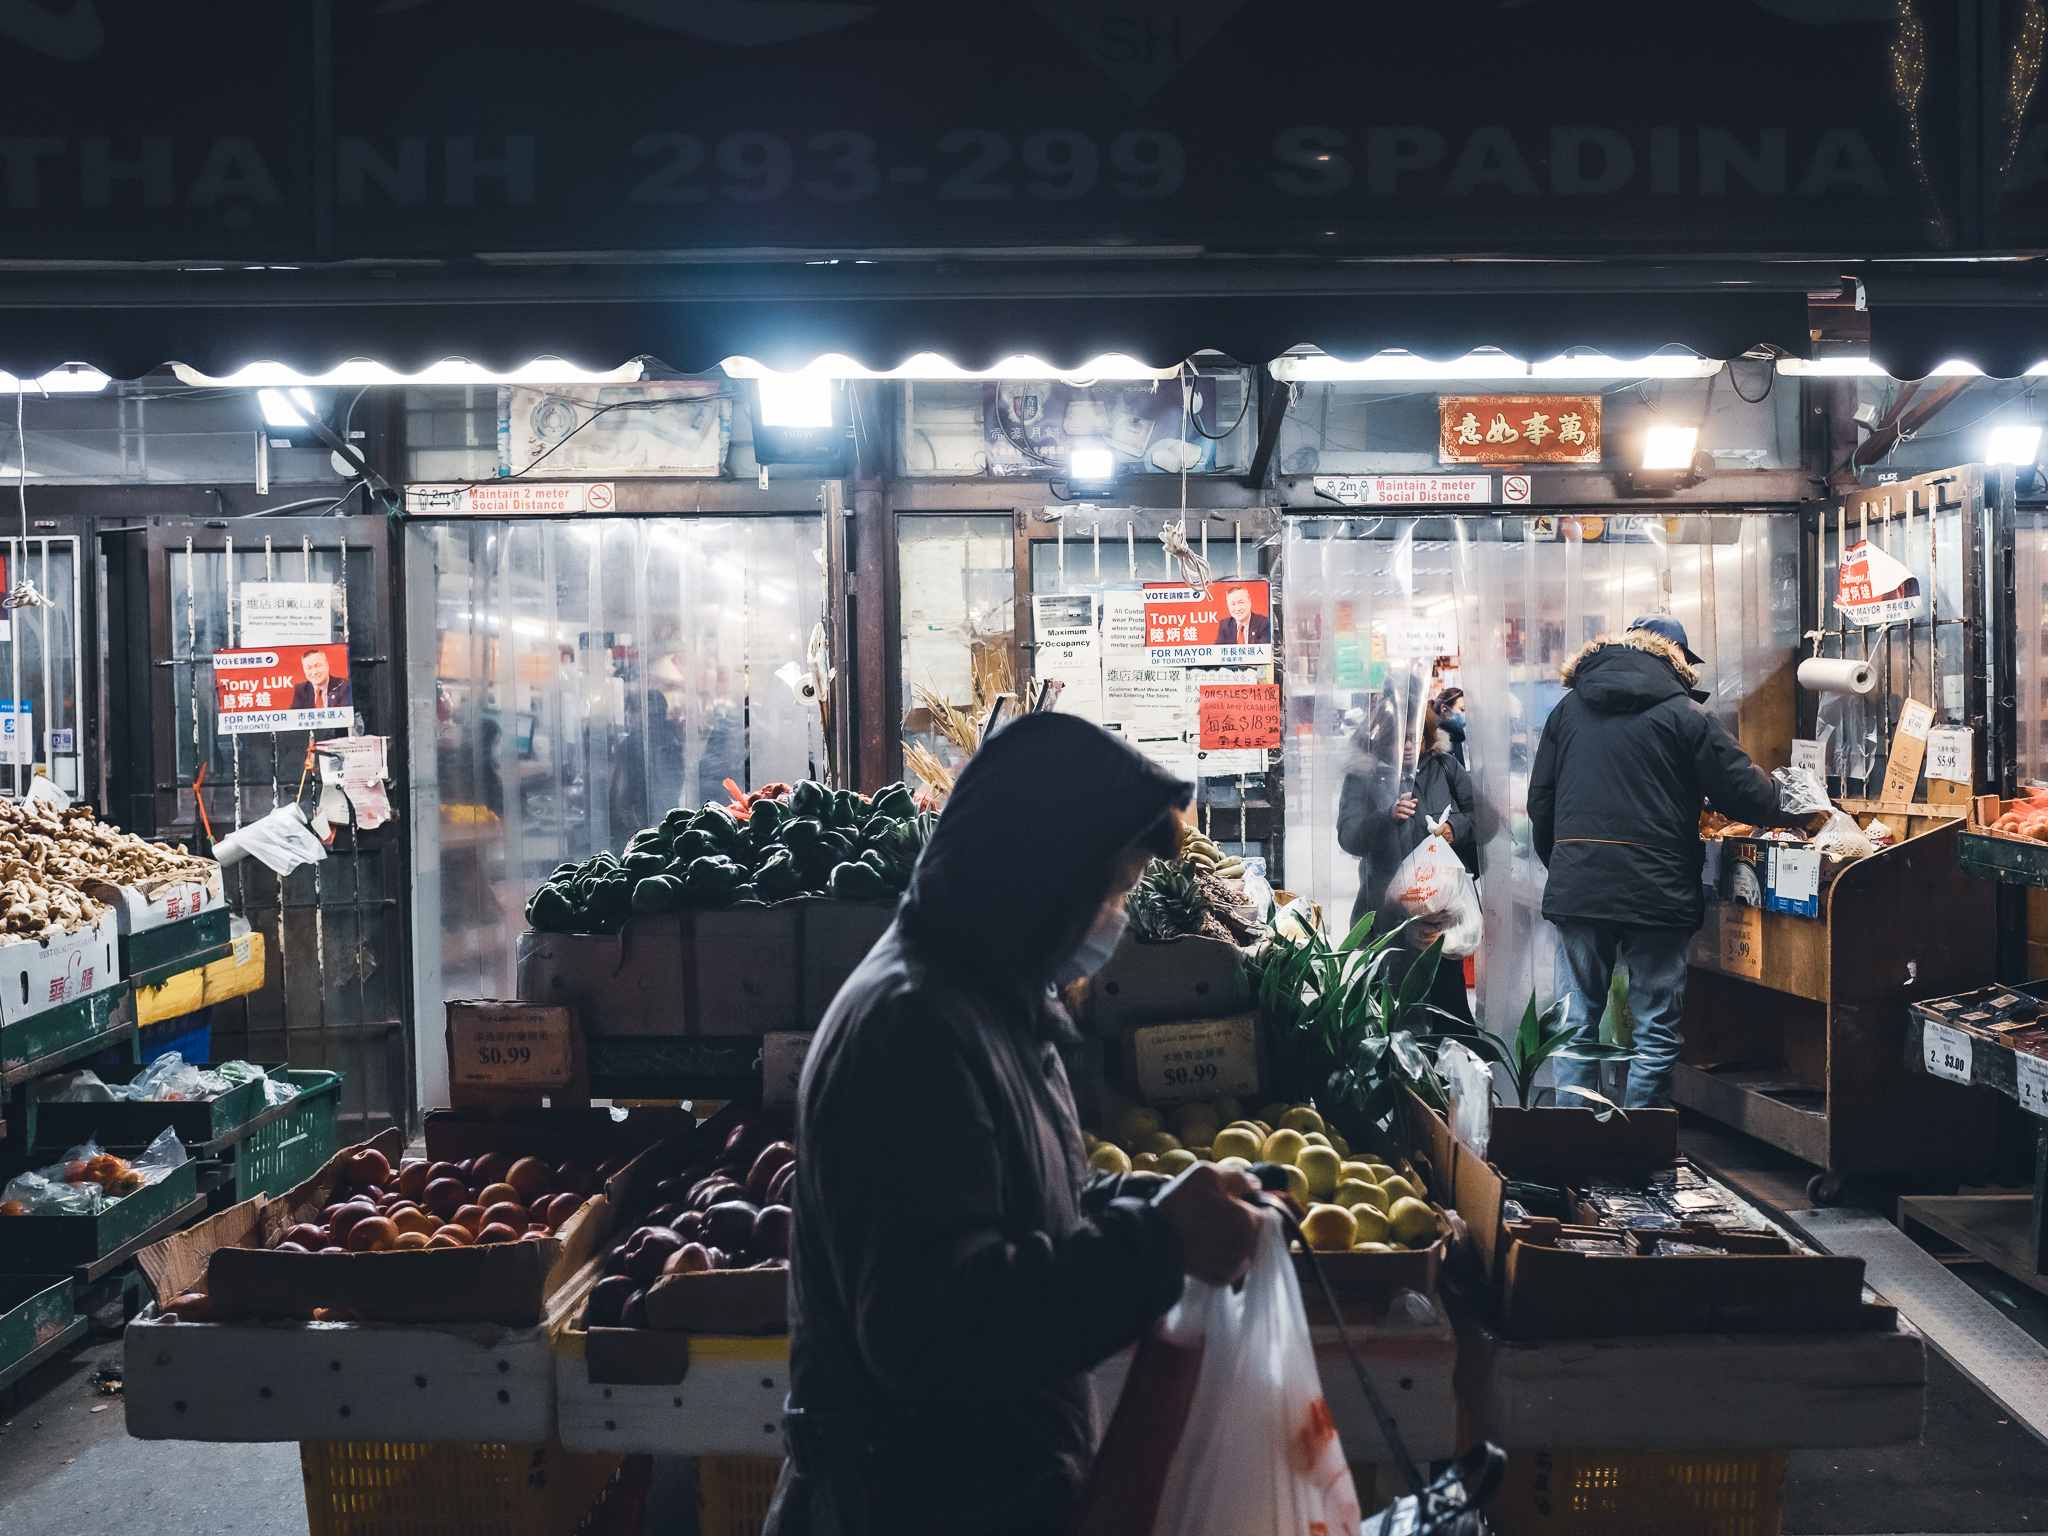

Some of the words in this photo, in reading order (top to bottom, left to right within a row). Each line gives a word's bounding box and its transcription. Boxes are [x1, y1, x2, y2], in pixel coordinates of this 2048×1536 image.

[630, 128, 1188, 201] 293-299
[1270, 125, 1892, 198] SPADINA
[1339, 481, 1357, 491] 2m
[1376, 480, 1427, 490] Maintain
[1431, 480, 1437, 490] 2
[1442, 480, 1475, 490] meter
[469, 489, 519, 499] Maintain
[524, 489, 531, 498] 2
[535, 489, 570, 498] meter
[1379, 491, 1416, 502] Social
[1419, 491, 1471, 501] Distance
[472, 500, 508, 510] Social
[513, 500, 565, 510] Distance
[1561, 521, 1603, 531] MastrCard
[1614, 516, 1650, 530] VISA
[246, 597, 325, 610] 進店須戴口罩
[1886, 600, 1916, 612] 市長候選人
[1856, 605, 1881, 616] MAYOR
[1150, 613, 1186, 627] Tony
[1190, 611, 1218, 624] LUK
[1150, 627, 1198, 643] 陸炳雄
[1045, 640, 1090, 648] Occupancy
[1151, 649, 1171, 658] FOR
[1174, 648, 1213, 657] MAYOR
[1220, 647, 1264, 656] 市長候選人
[1107, 670, 1180, 682] 進店須戴口罩
[220, 679, 259, 693] Tony
[263, 675, 294, 690] LUK
[223, 691, 272, 710] 陸炳雄
[224, 714, 243, 724] FOR
[247, 713, 288, 723] MAYOR
[297, 710, 346, 721] 市長候選人
[1937, 755, 1956, 768] $5.99
[478, 1046, 531, 1065] $0.99
[1930, 1050, 1936, 1062] 2
[1944, 1054, 1964, 1072] $3.00
[1164, 1063, 1218, 1086] $0.99
[2026, 1084, 2030, 1097] 2
